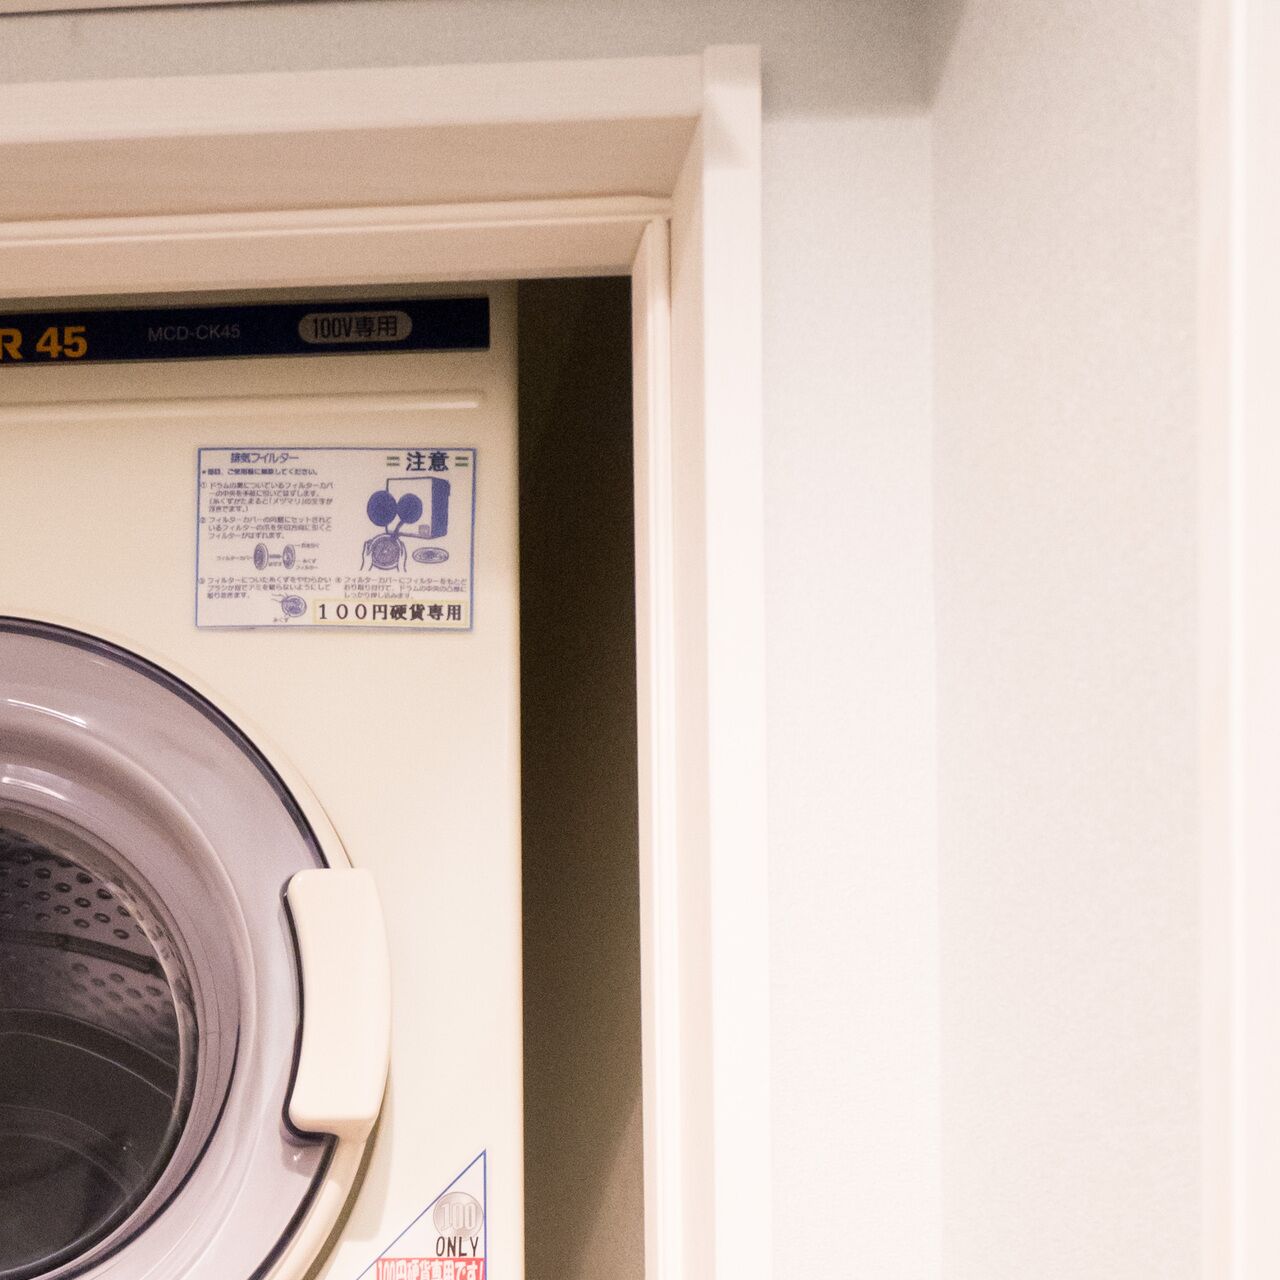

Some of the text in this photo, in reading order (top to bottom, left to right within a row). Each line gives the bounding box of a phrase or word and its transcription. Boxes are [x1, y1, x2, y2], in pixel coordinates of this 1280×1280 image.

[312, 316, 398, 339] 100V専用
[35, 326, 88, 359] 45
[406, 452, 449, 472] 注意
[319, 603, 462, 621] 100円硬貨専用
[436, 1236, 479, 1257] ONLY
